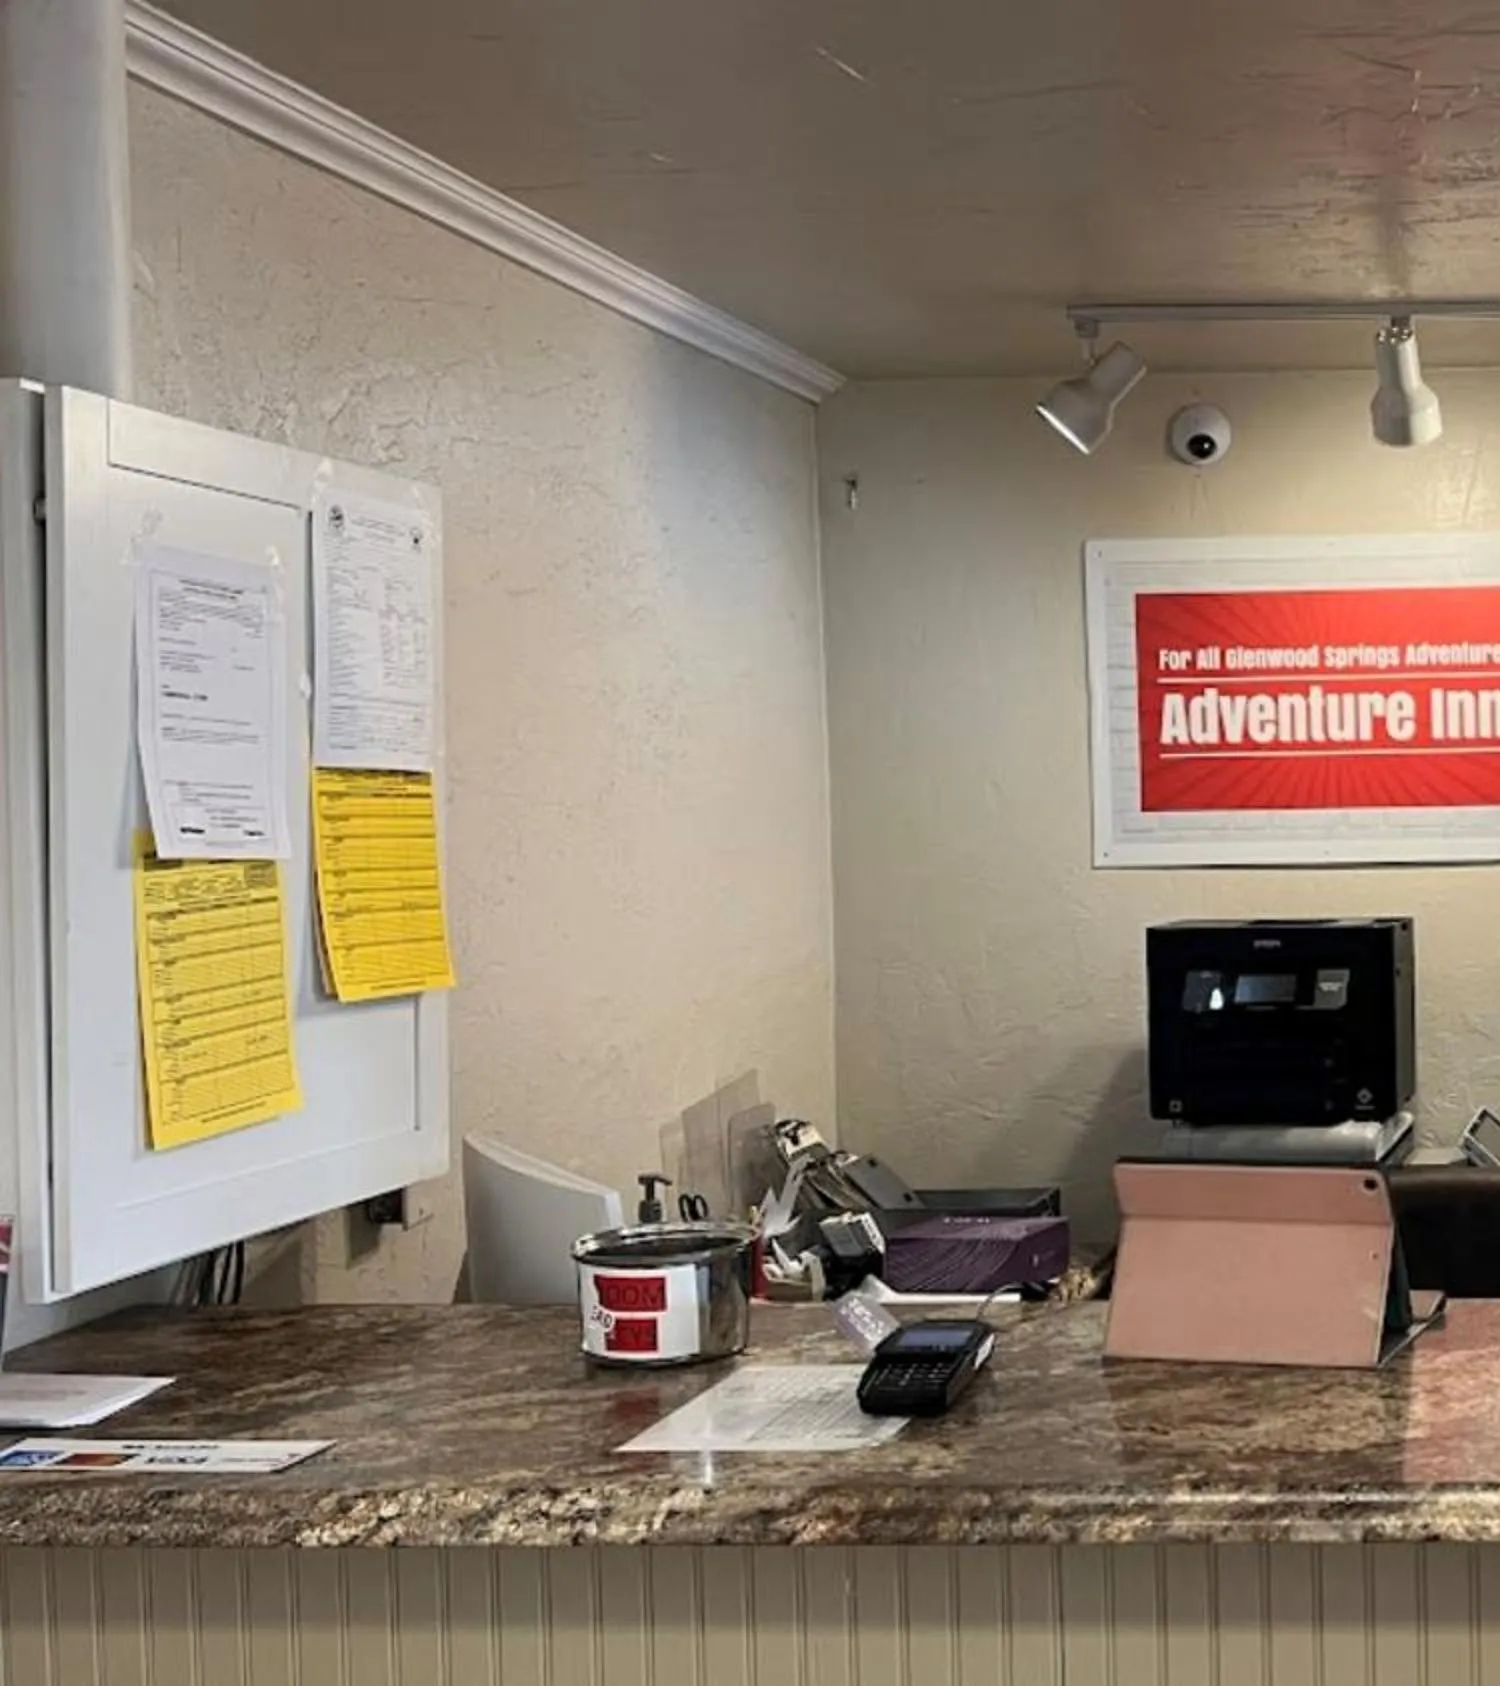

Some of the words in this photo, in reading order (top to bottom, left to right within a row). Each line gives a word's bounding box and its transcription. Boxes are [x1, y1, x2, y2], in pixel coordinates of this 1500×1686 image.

[1158, 650, 1191, 670] For
[1197, 647, 1220, 670] All
[1225, 645, 1319, 669] Glenwood
[1325, 644, 1398, 668] Springs
[1159, 686, 1416, 745] Adventure
